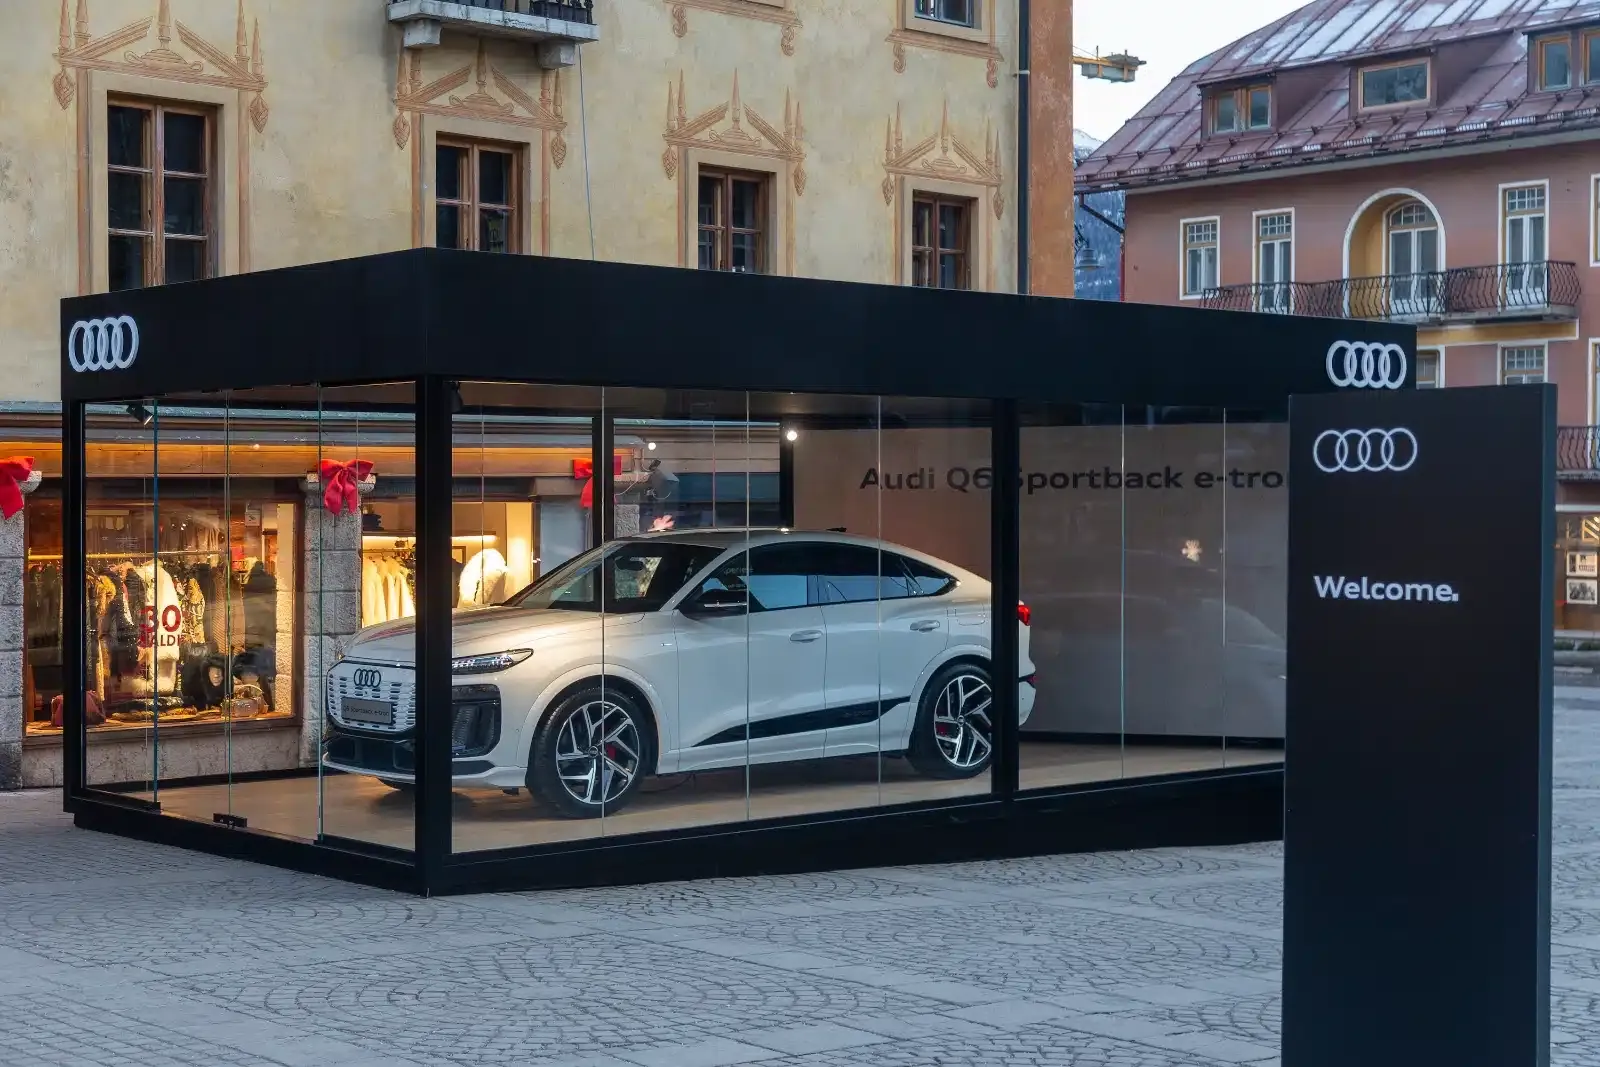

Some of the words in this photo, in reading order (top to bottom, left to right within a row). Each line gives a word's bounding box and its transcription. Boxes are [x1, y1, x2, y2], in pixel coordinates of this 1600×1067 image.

[860, 467, 935, 490] Audi
[946, 467, 992, 493] Q6
[1019, 466, 1184, 495] portback
[1194, 467, 1289, 489] e-tro
[1313, 575, 1459, 602] Welcome.
